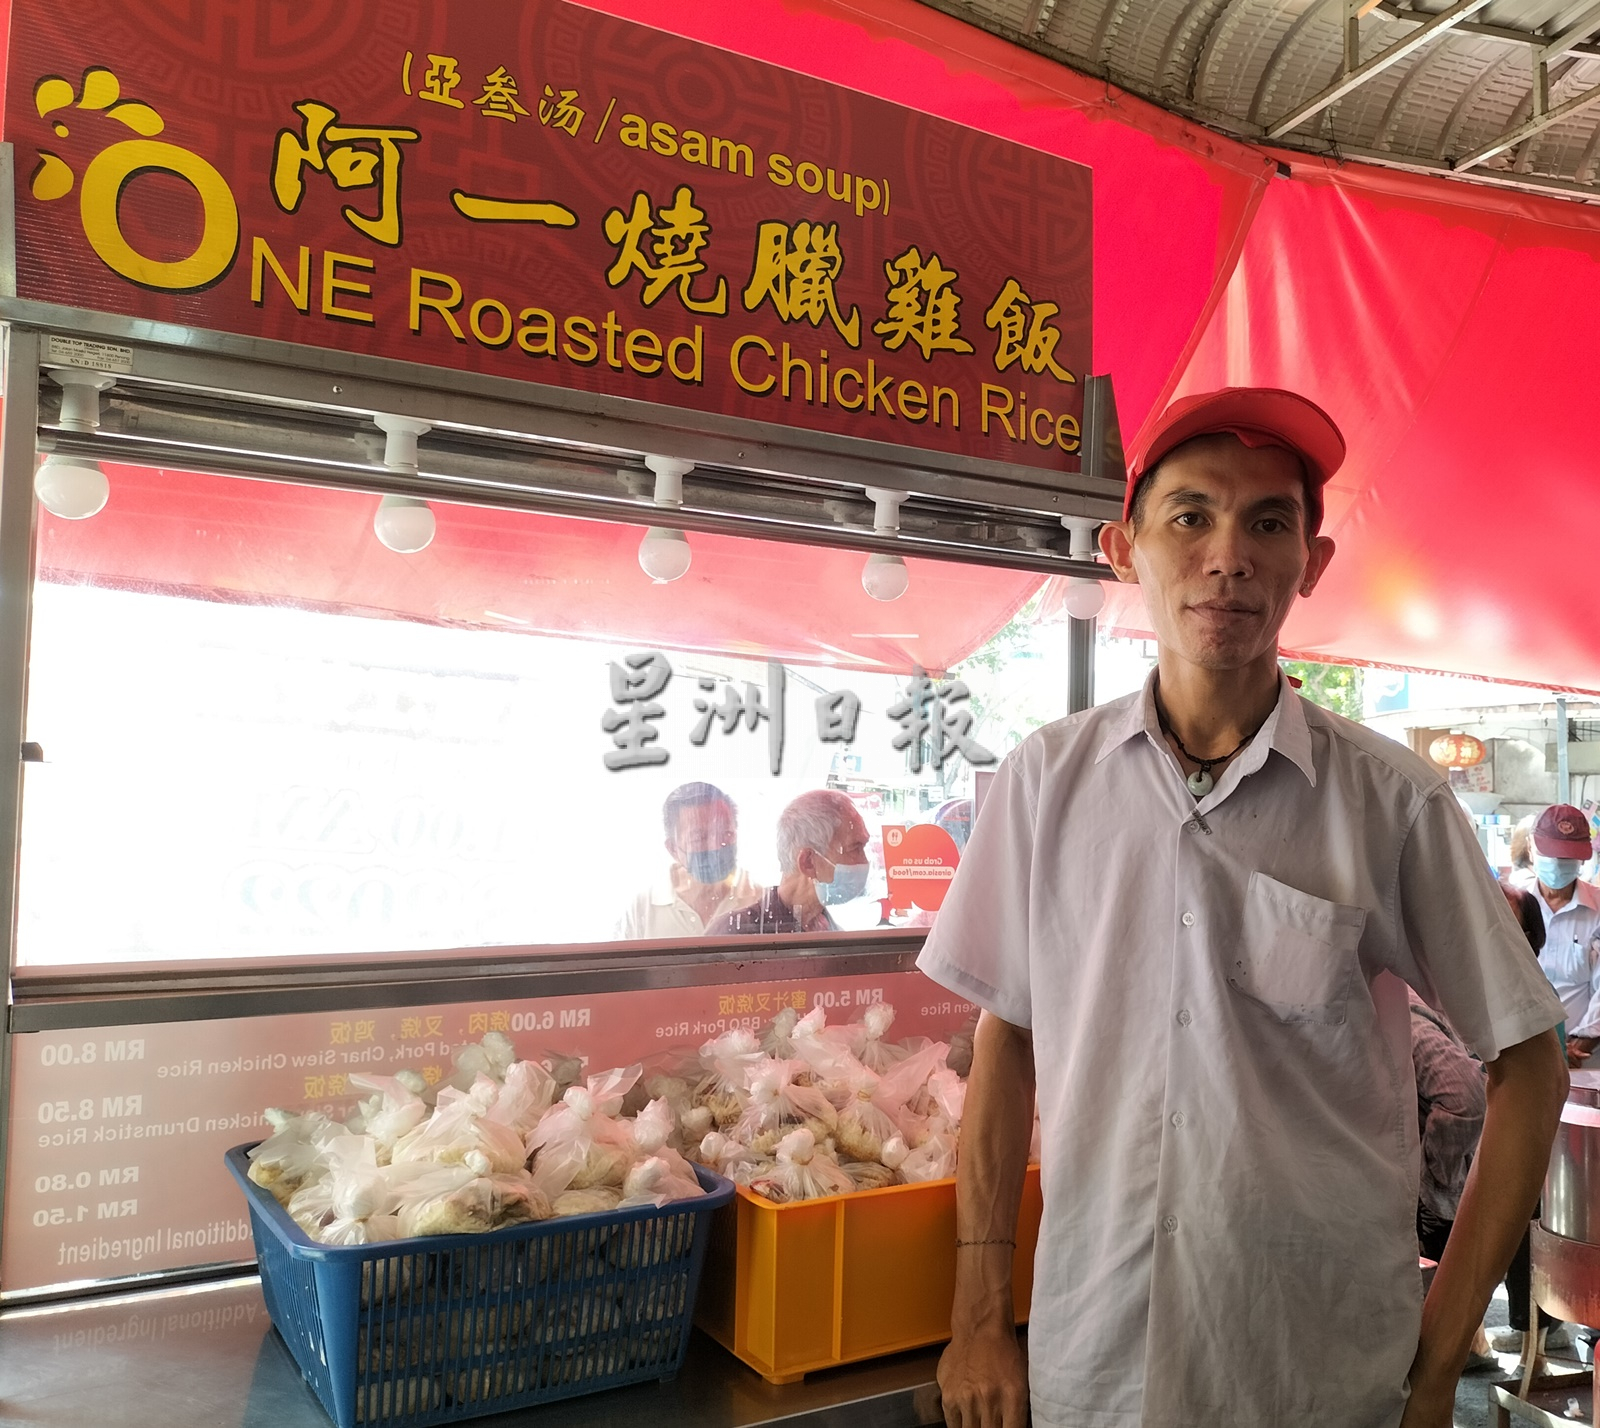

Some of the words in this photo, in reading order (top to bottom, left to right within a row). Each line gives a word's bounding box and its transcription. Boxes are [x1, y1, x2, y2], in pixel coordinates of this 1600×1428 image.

[768, 152, 891, 218] soup)
[80, 138, 376, 325] ONE
[408, 267, 704, 385] Roasted
[729, 335, 960, 430] Chicken
[981, 382, 1082, 453] Rice
[51, 337, 71, 345] DOUBLE
[84, 342, 106, 350] TRADING
